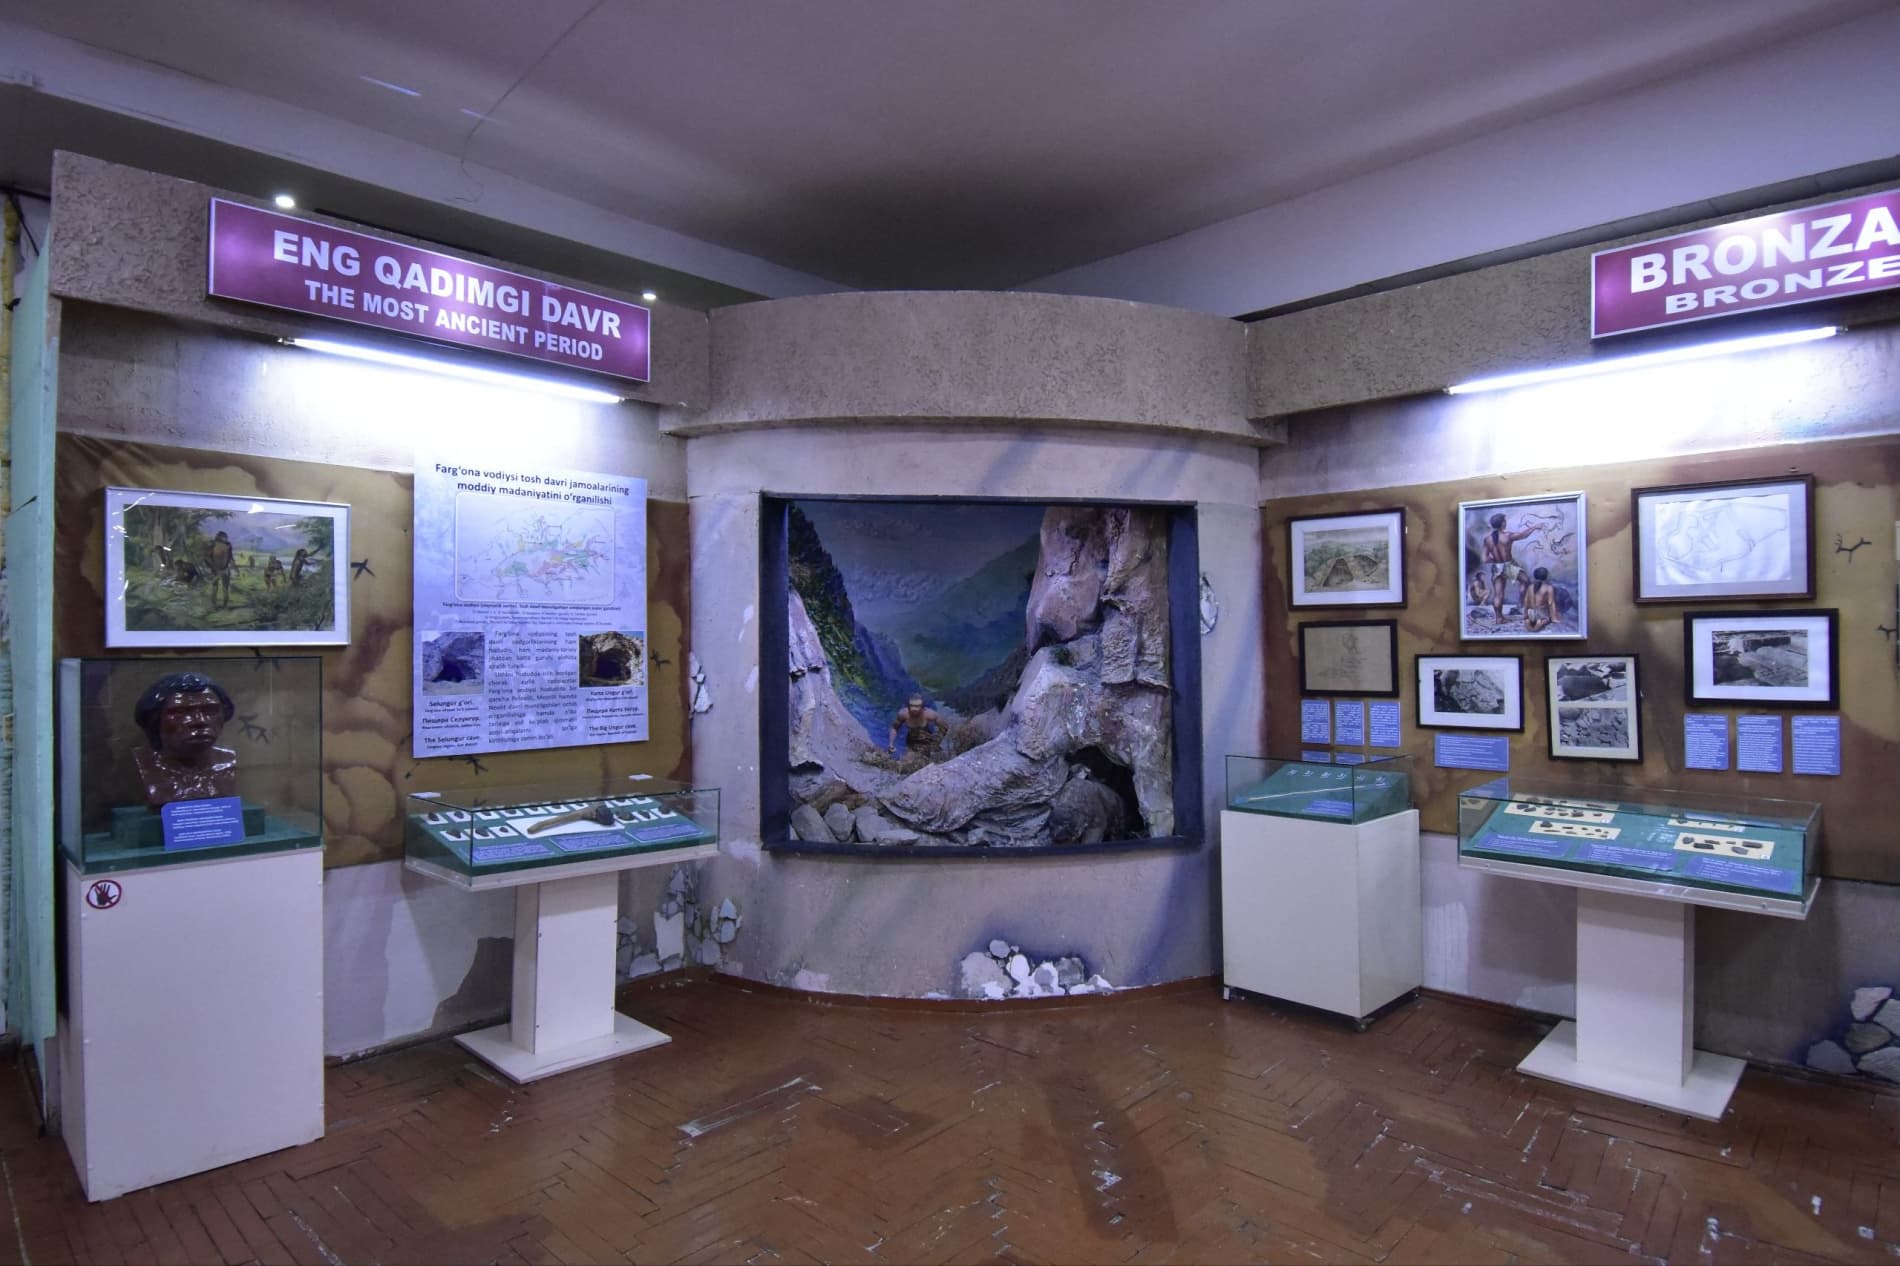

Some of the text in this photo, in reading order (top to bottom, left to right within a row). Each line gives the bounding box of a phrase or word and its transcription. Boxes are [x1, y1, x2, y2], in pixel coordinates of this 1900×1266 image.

[273, 229, 621, 339] ENG QADIMGI DAVR
[1631, 206, 1900, 294] BRONZA
[1665, 254, 1900, 315] BRONZE
[304, 279, 603, 361] THE MOST ANCIENT PERIOD
[457, 482, 496, 495] moddiy
[499, 486, 562, 501] madaniyatini
[484, 468, 518, 482] vodiysi
[521, 473, 541, 485] tosh
[544, 476, 568, 488] davri
[569, 479, 630, 496] jamoalarining
